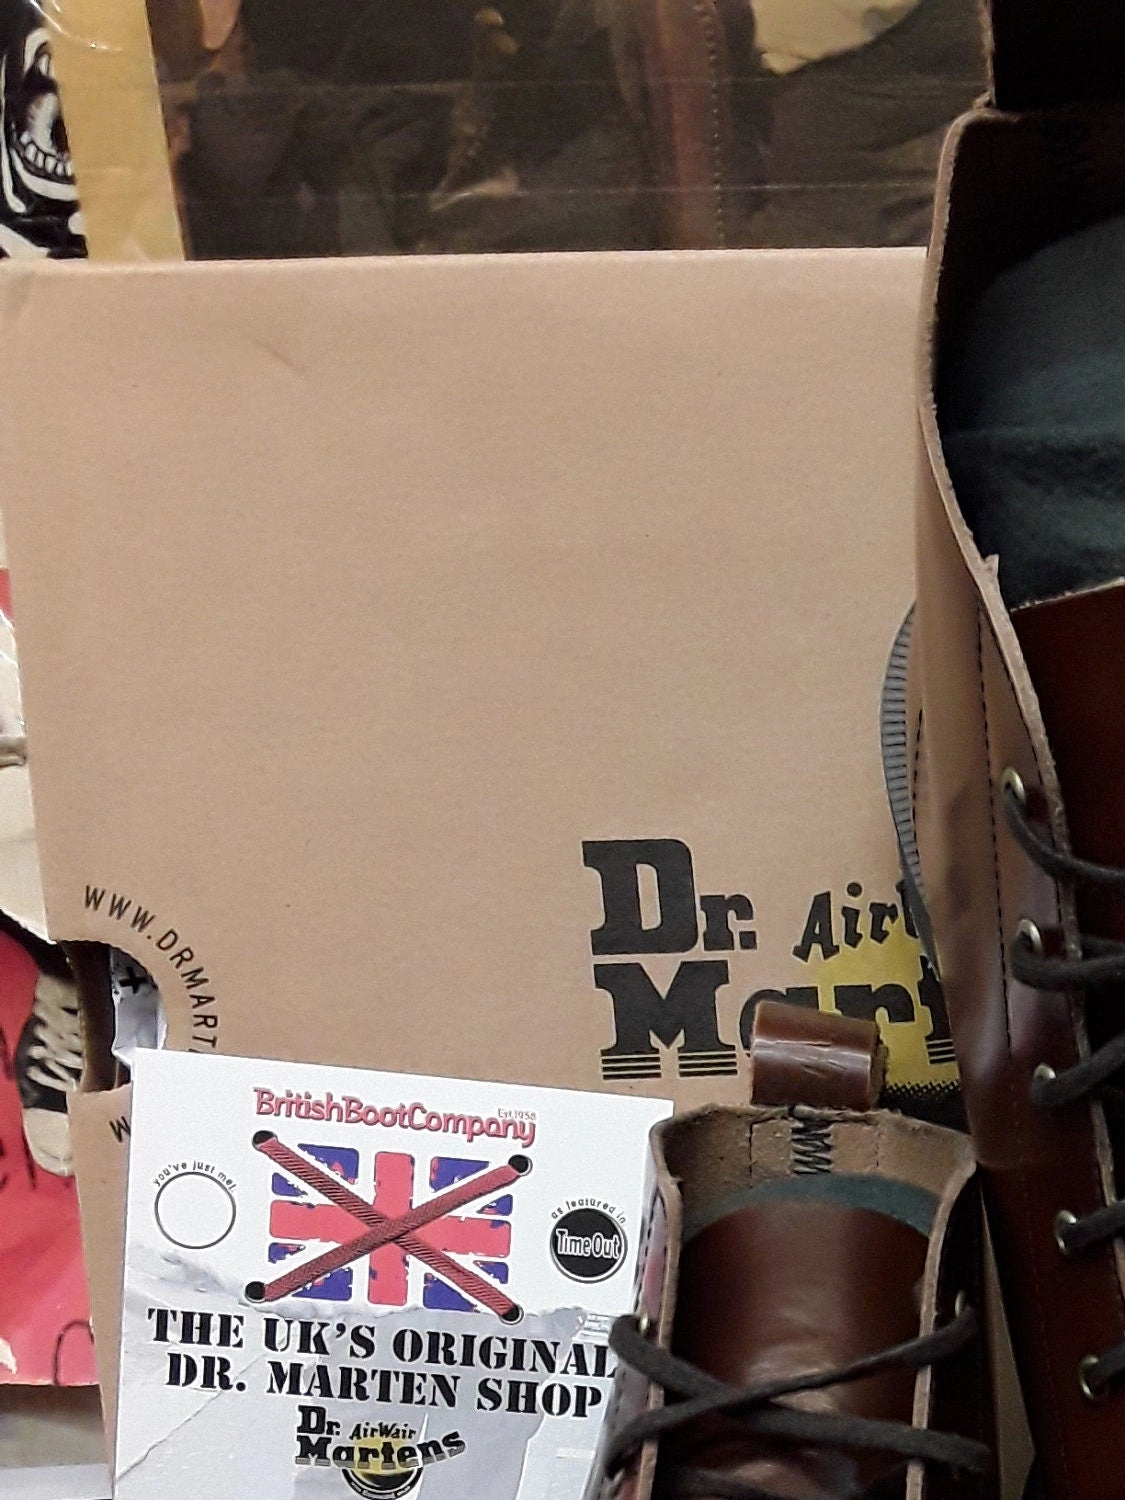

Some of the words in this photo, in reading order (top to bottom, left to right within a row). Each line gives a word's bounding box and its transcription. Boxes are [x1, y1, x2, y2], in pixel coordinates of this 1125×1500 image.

[582, 839, 757, 955] Dr.
[84, 885, 218, 1053] WWW.DRMART
[193, 1161, 215, 1173] just
[148, 1308, 244, 1348] THE
[264, 1318, 375, 1358] UK'S
[392, 1329, 616, 1378] ORIGINAL
[166, 1353, 246, 1391] DR.
[266, 1361, 460, 1407] MARTEN
[477, 1378, 602, 1418] SHOP
[295, 1431, 466, 1470] Martens
[297, 1405, 340, 1436] Dr.
